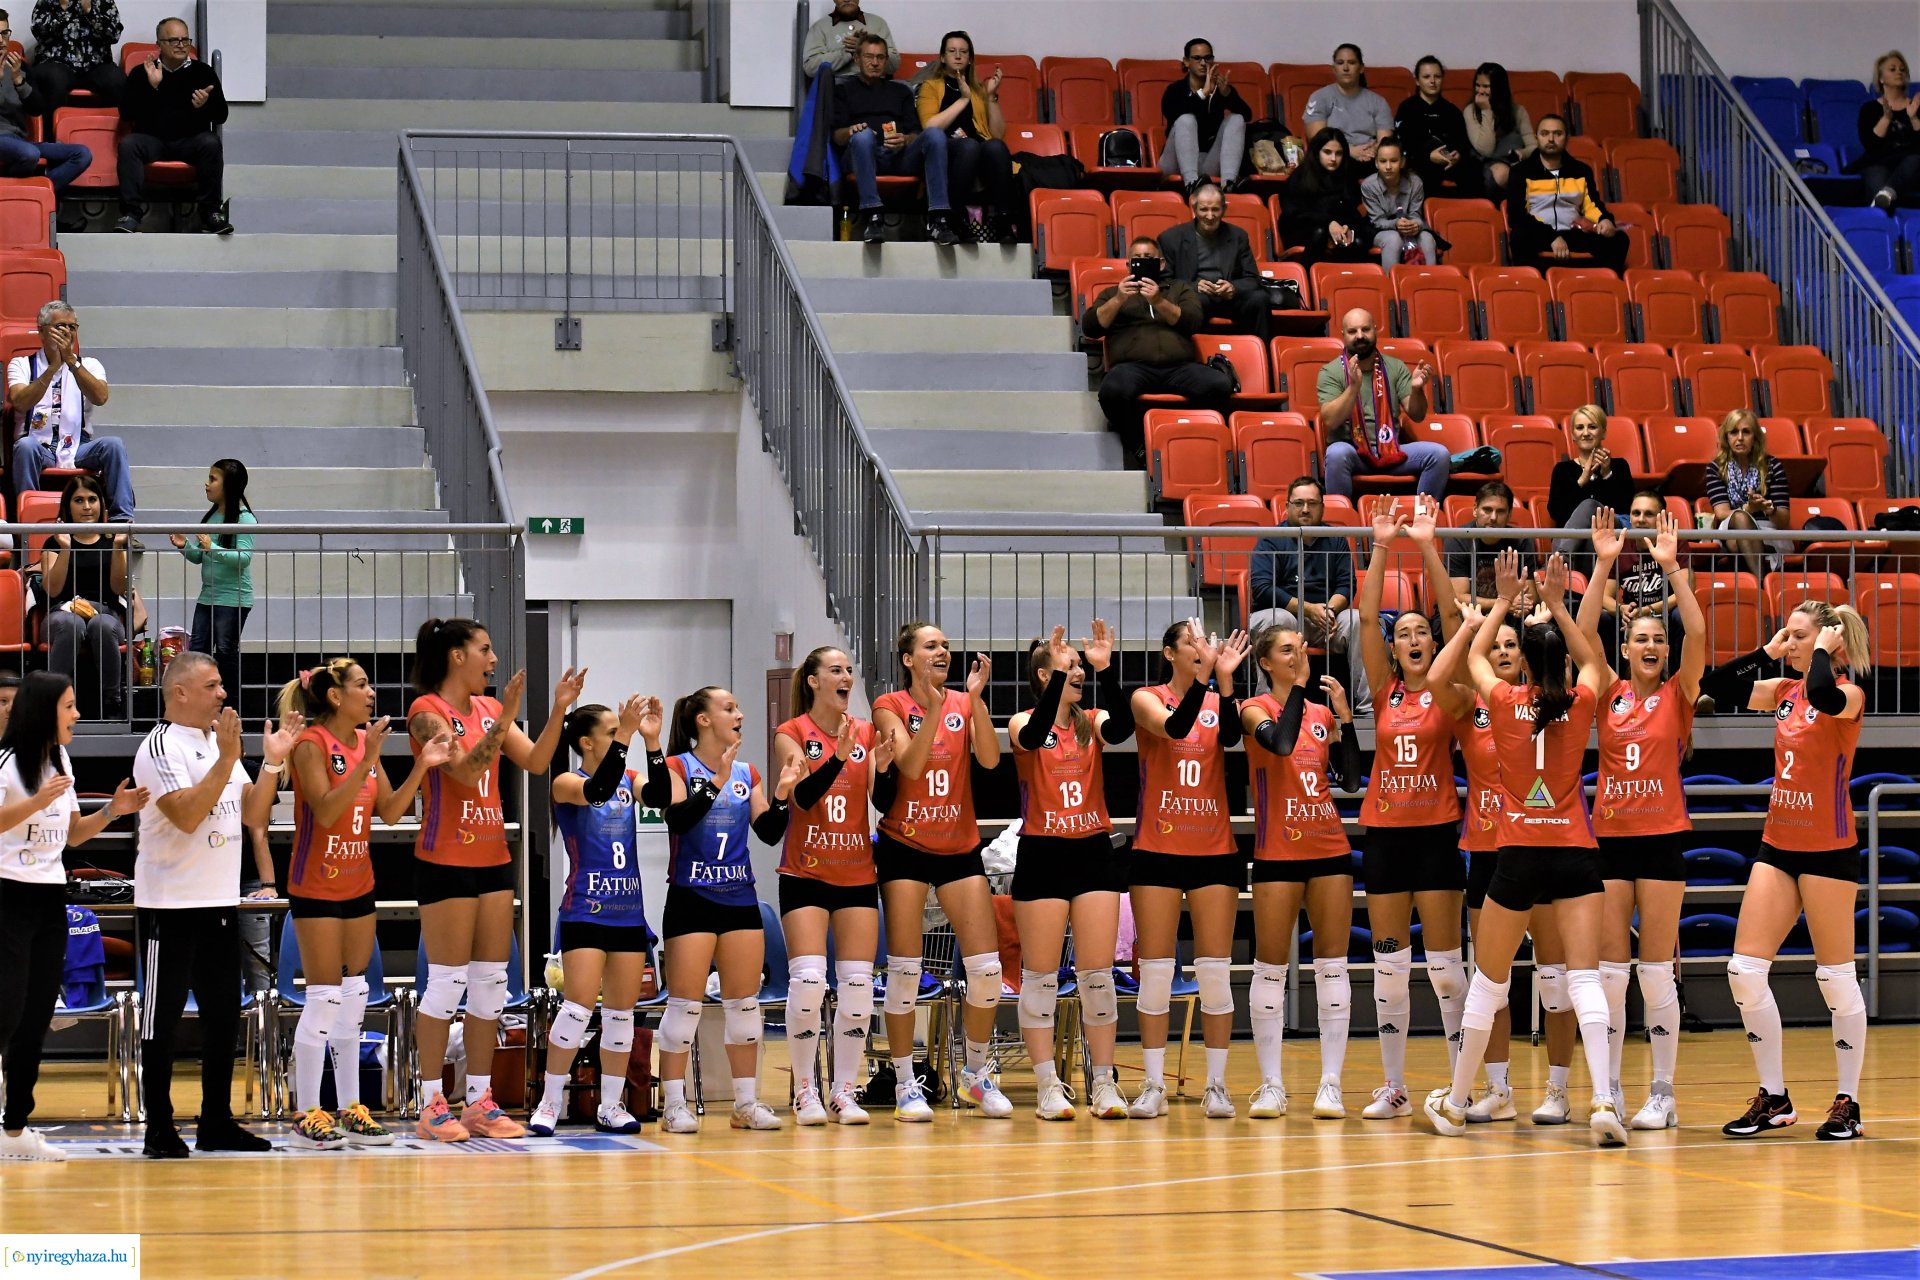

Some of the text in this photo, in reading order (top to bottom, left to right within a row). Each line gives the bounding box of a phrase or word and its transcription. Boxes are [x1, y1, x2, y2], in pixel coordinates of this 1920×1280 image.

[1393, 735, 1418, 763] 15
[1531, 728, 1545, 770] 1
[1625, 743, 1640, 771] 9
[1177, 759, 1201, 788] 10
[1380, 769, 1438, 789] FATUM
[1781, 751, 1794, 780] 2
[925, 769, 949, 797] 19
[1059, 781, 1083, 809] 13
[1300, 771, 1320, 797] 12
[1604, 775, 1664, 795] FATUM
[825, 795, 847, 823] 18
[906, 800, 961, 820] FATUM
[1160, 790, 1219, 812] FATUM
[1284, 797, 1336, 817] FATUM
[352, 806, 364, 835] 5
[1043, 811, 1102, 830] FATUM
[716, 832, 728, 861] 7
[804, 824, 865, 847] FATUM
[611, 841, 626, 870] 8
[689, 860, 747, 879] FATUM
[586, 870, 640, 891] FATUM
